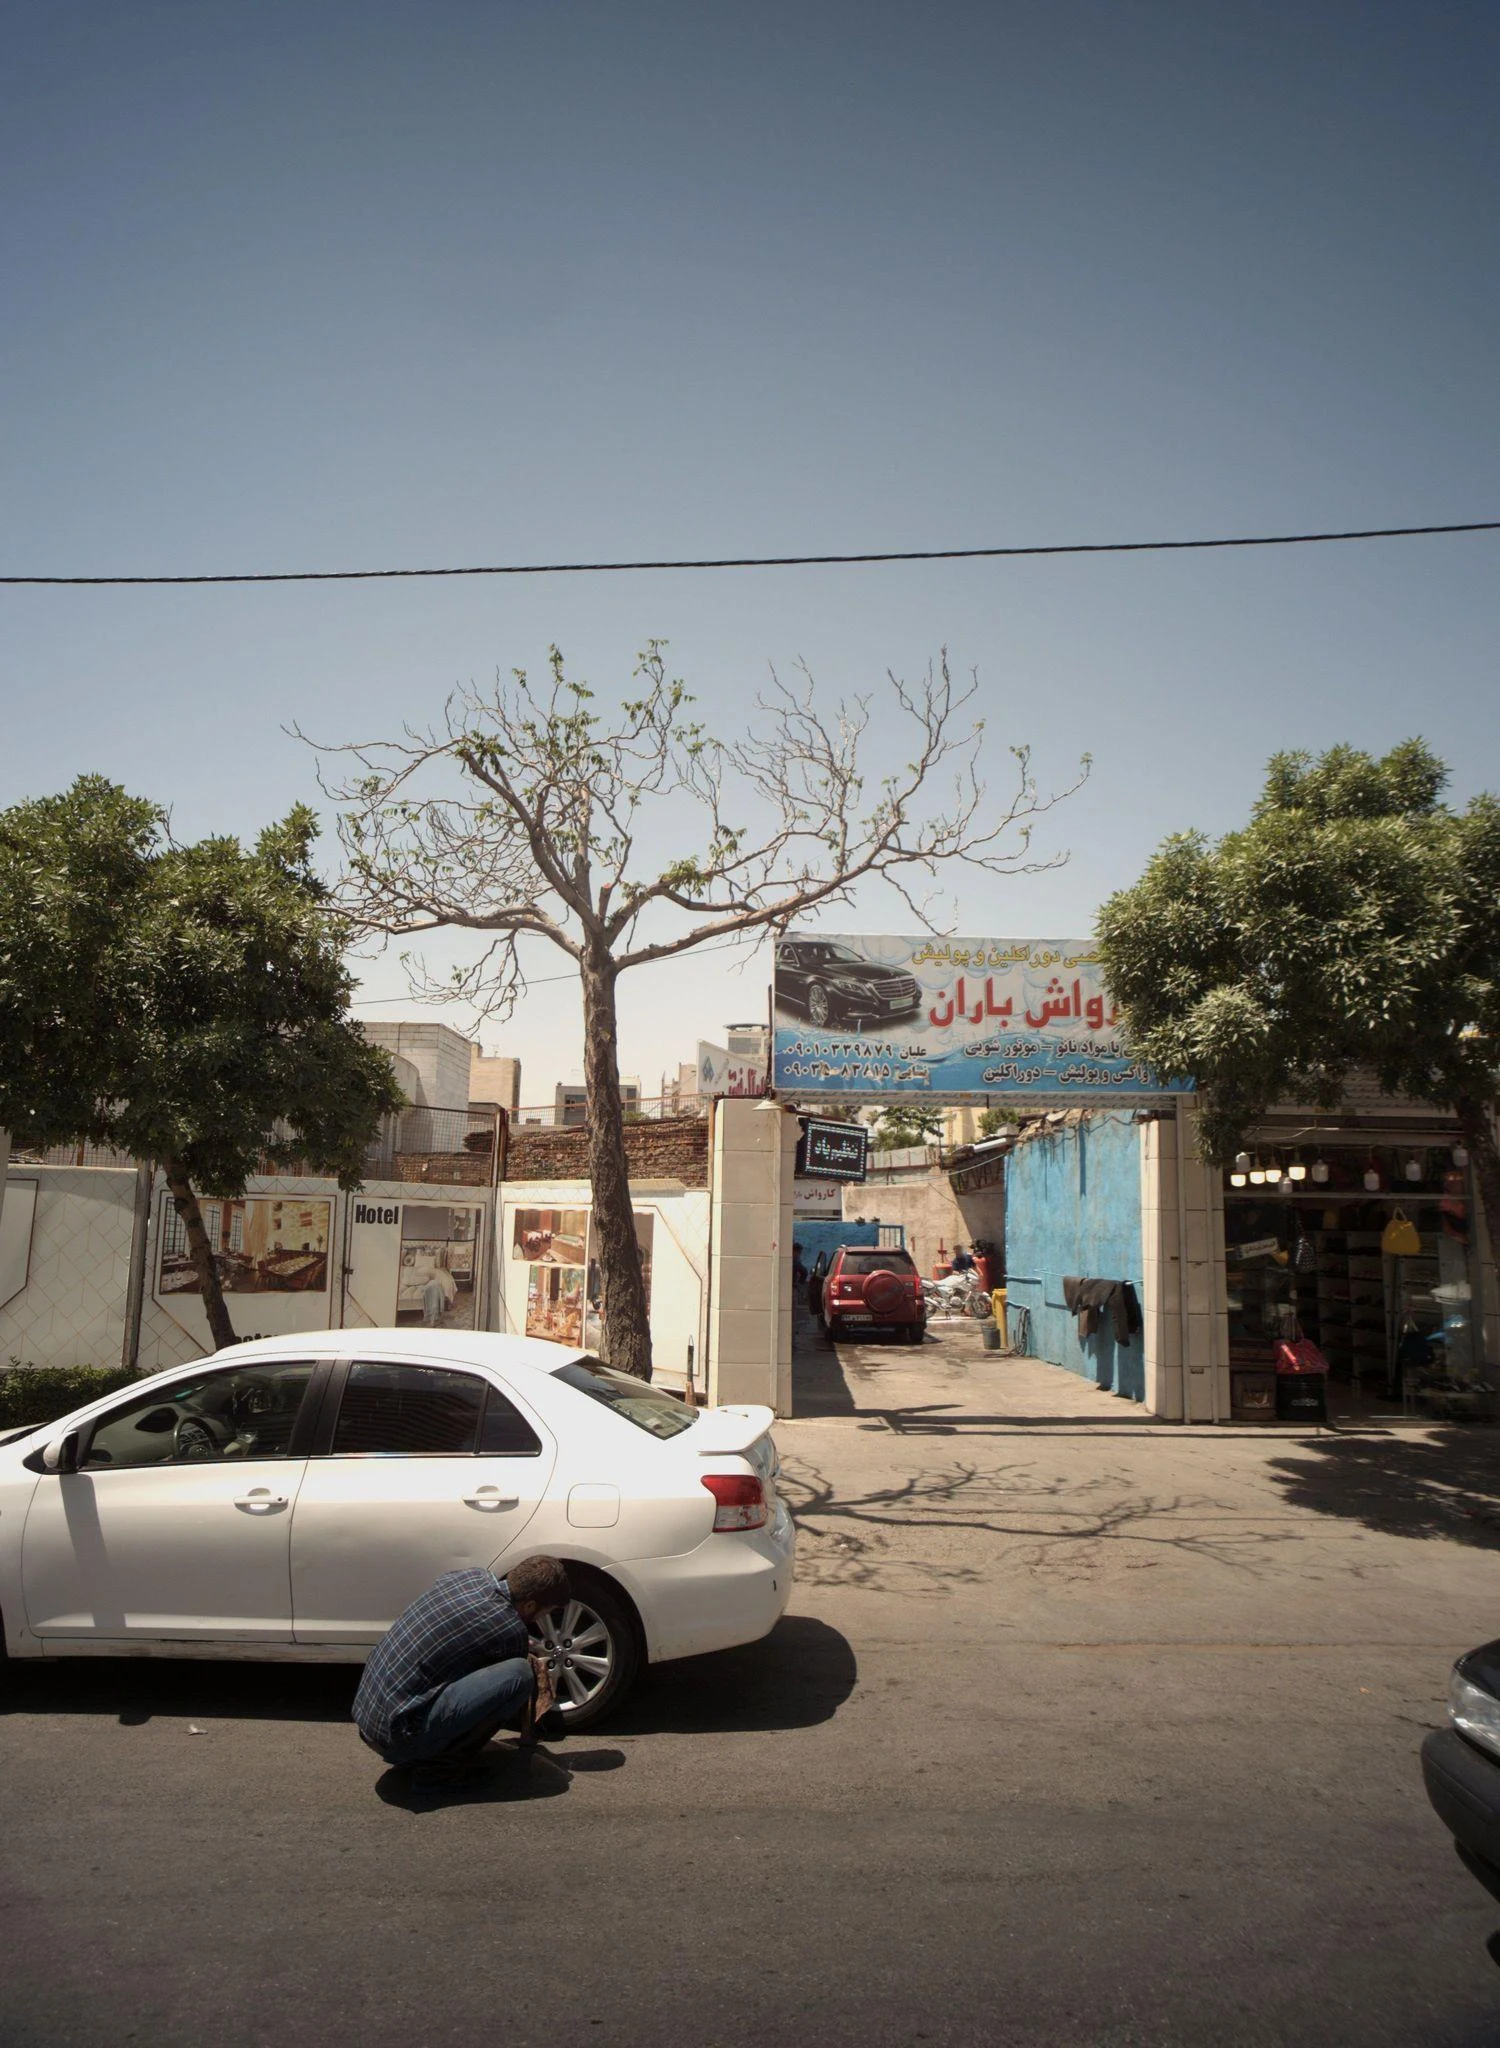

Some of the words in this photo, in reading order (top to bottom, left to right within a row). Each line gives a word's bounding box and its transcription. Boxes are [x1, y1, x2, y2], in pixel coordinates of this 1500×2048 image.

[912, 943, 970, 967] پولیش
[929, 977, 1013, 1028] باران
[1025, 978, 1119, 1029] رواش
[1056, 1042, 1077, 1057] نانو
[1080, 1041, 1108, 1057] مواد
[355, 1204, 399, 1224] Hotel
